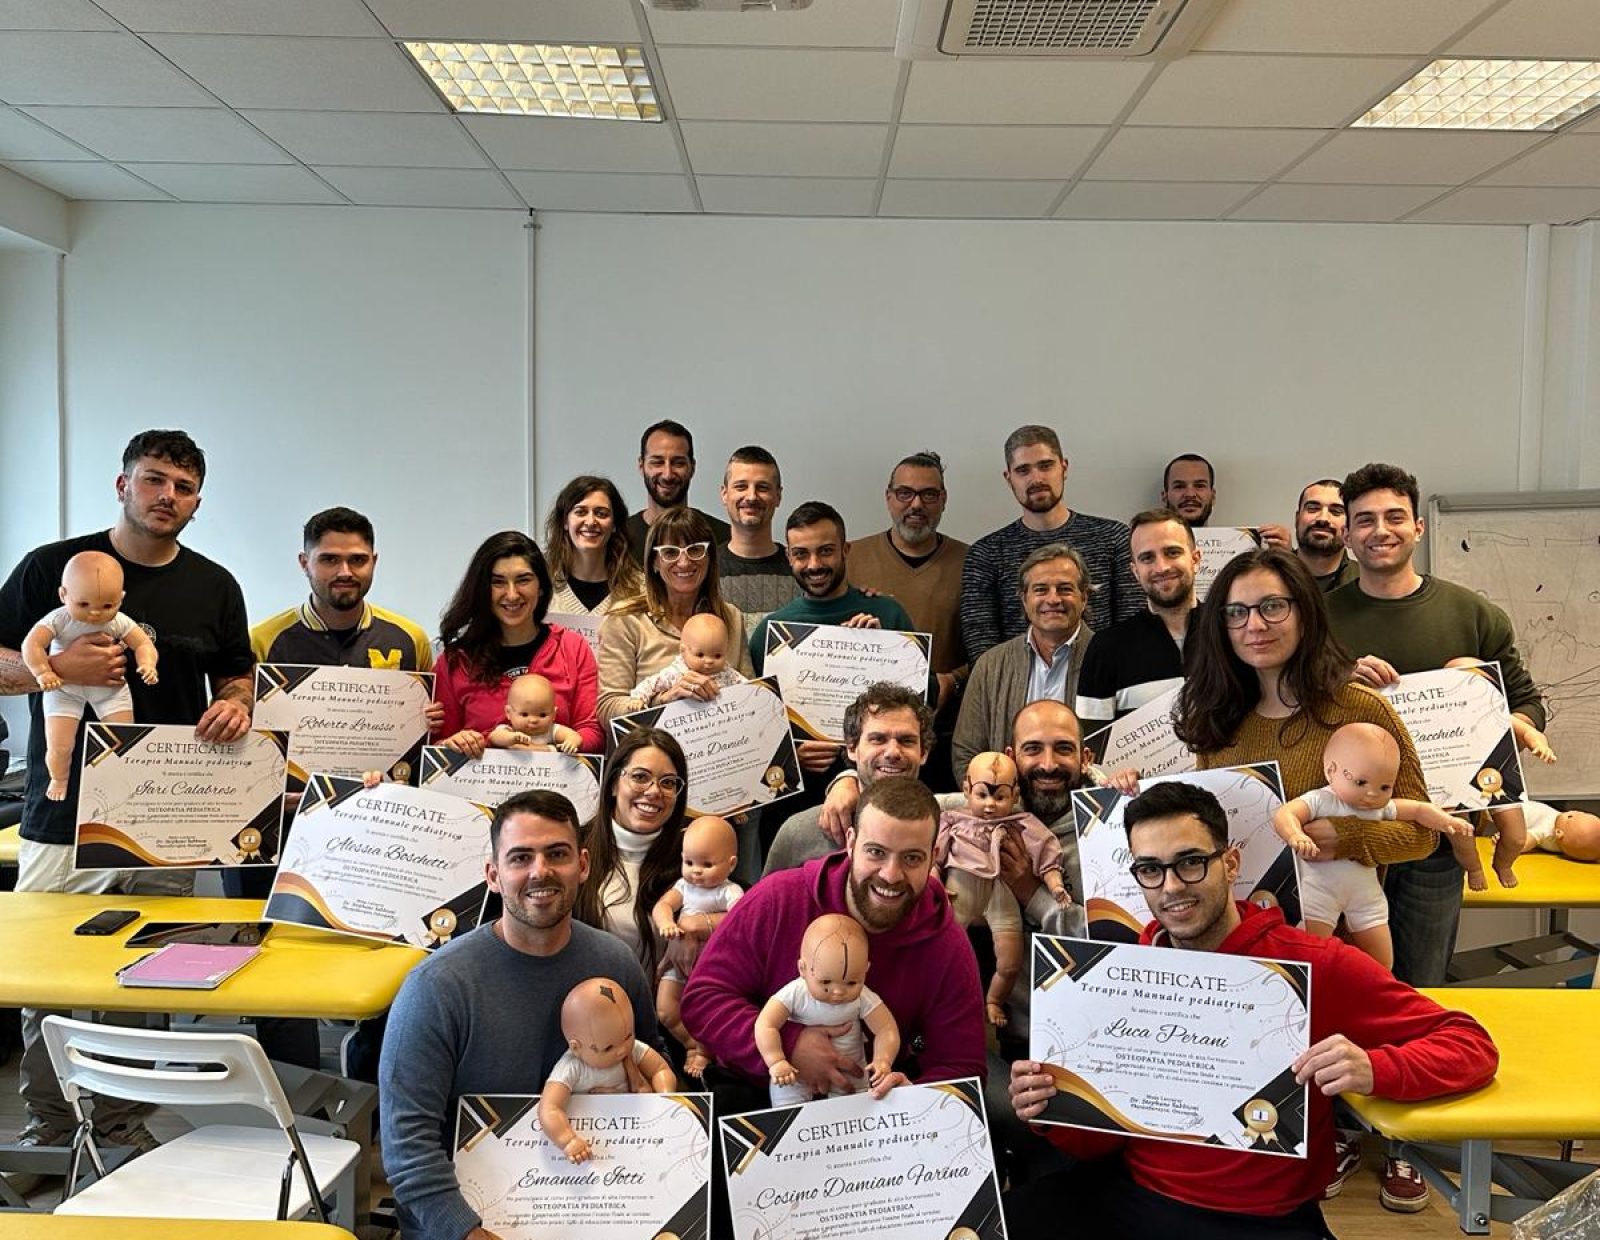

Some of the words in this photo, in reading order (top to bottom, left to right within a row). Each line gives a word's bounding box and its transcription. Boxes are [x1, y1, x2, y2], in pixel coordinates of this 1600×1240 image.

[812, 639, 883, 652] CERTIFICATE
[311, 681, 392, 694] CERTIFICATE
[292, 694, 327, 703] Terapia
[299, 715, 346, 729] Roberto
[350, 718, 394, 732] Lorusso
[664, 701, 738, 728] CERTIFICATE
[146, 742, 234, 755] CERTIFICATE
[124, 757, 161, 766] Terapia
[164, 758, 203, 766] Manuale
[206, 759, 253, 768] pediatrica
[472, 764, 551, 777] CERTIFICATE
[171, 781, 237, 795] Calabrese
[356, 797, 448, 824] CERTIFICATE
[334, 810, 368, 822] Terapia
[372, 815, 409, 829] Manuale
[412, 823, 463, 841] pediatrica
[326, 836, 381, 856] Alessia
[384, 844, 450, 870] Boschetti
[1107, 966, 1227, 992] CERTIFICATE
[1081, 982, 1128, 997] Terapia
[1133, 989, 1184, 1003] Manuale
[1189, 996, 1255, 1010] pediatrica
[1104, 1017, 1152, 1038] Luca
[1156, 1024, 1229, 1048] Perani
[1115, 1053, 1165, 1064] OSTEOPATIA
[1167, 1058, 1215, 1070] PEDIATRICA
[531, 1117, 640, 1132] CTIFICATE
[798, 1112, 910, 1142] CERTIFICATE
[504, 1138, 549, 1147] Terapia
[605, 1136, 664, 1147] pediatrica
[775, 1147, 821, 1163] Terapia
[825, 1140, 874, 1155] Manuale
[878, 1131, 939, 1149] pediatrica
[517, 1168, 601, 1188] Emanuele
[756, 1187, 819, 1210] Cosimo
[823, 1174, 904, 1198] Damiano
[907, 1163, 971, 1187] Farina
[820, 1211, 867, 1223] OSTEOPATIA
[869, 1203, 914, 1216] PEDIATRICA
